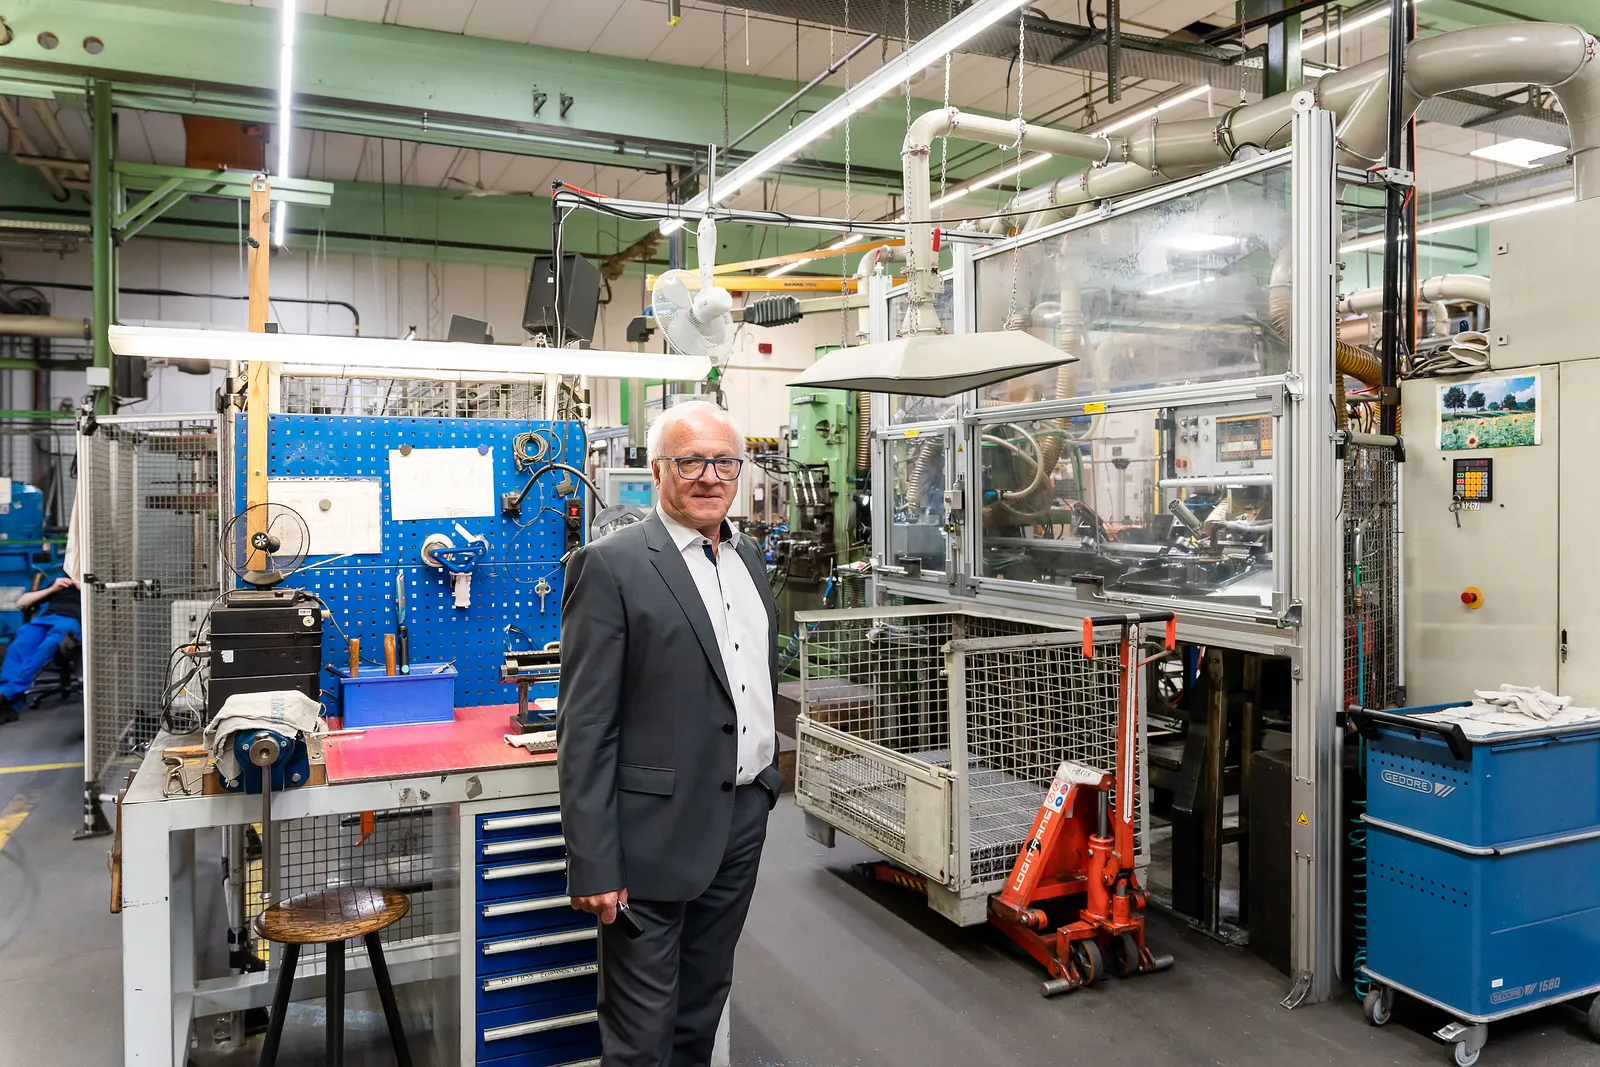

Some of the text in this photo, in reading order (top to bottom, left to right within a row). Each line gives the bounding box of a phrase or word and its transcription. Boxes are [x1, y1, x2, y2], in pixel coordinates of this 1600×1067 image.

[1385, 772, 1428, 791] GEDORE
[1013, 809, 1053, 891] LOGITRANS
[1493, 977, 1561, 1002] GEDORE 1580
